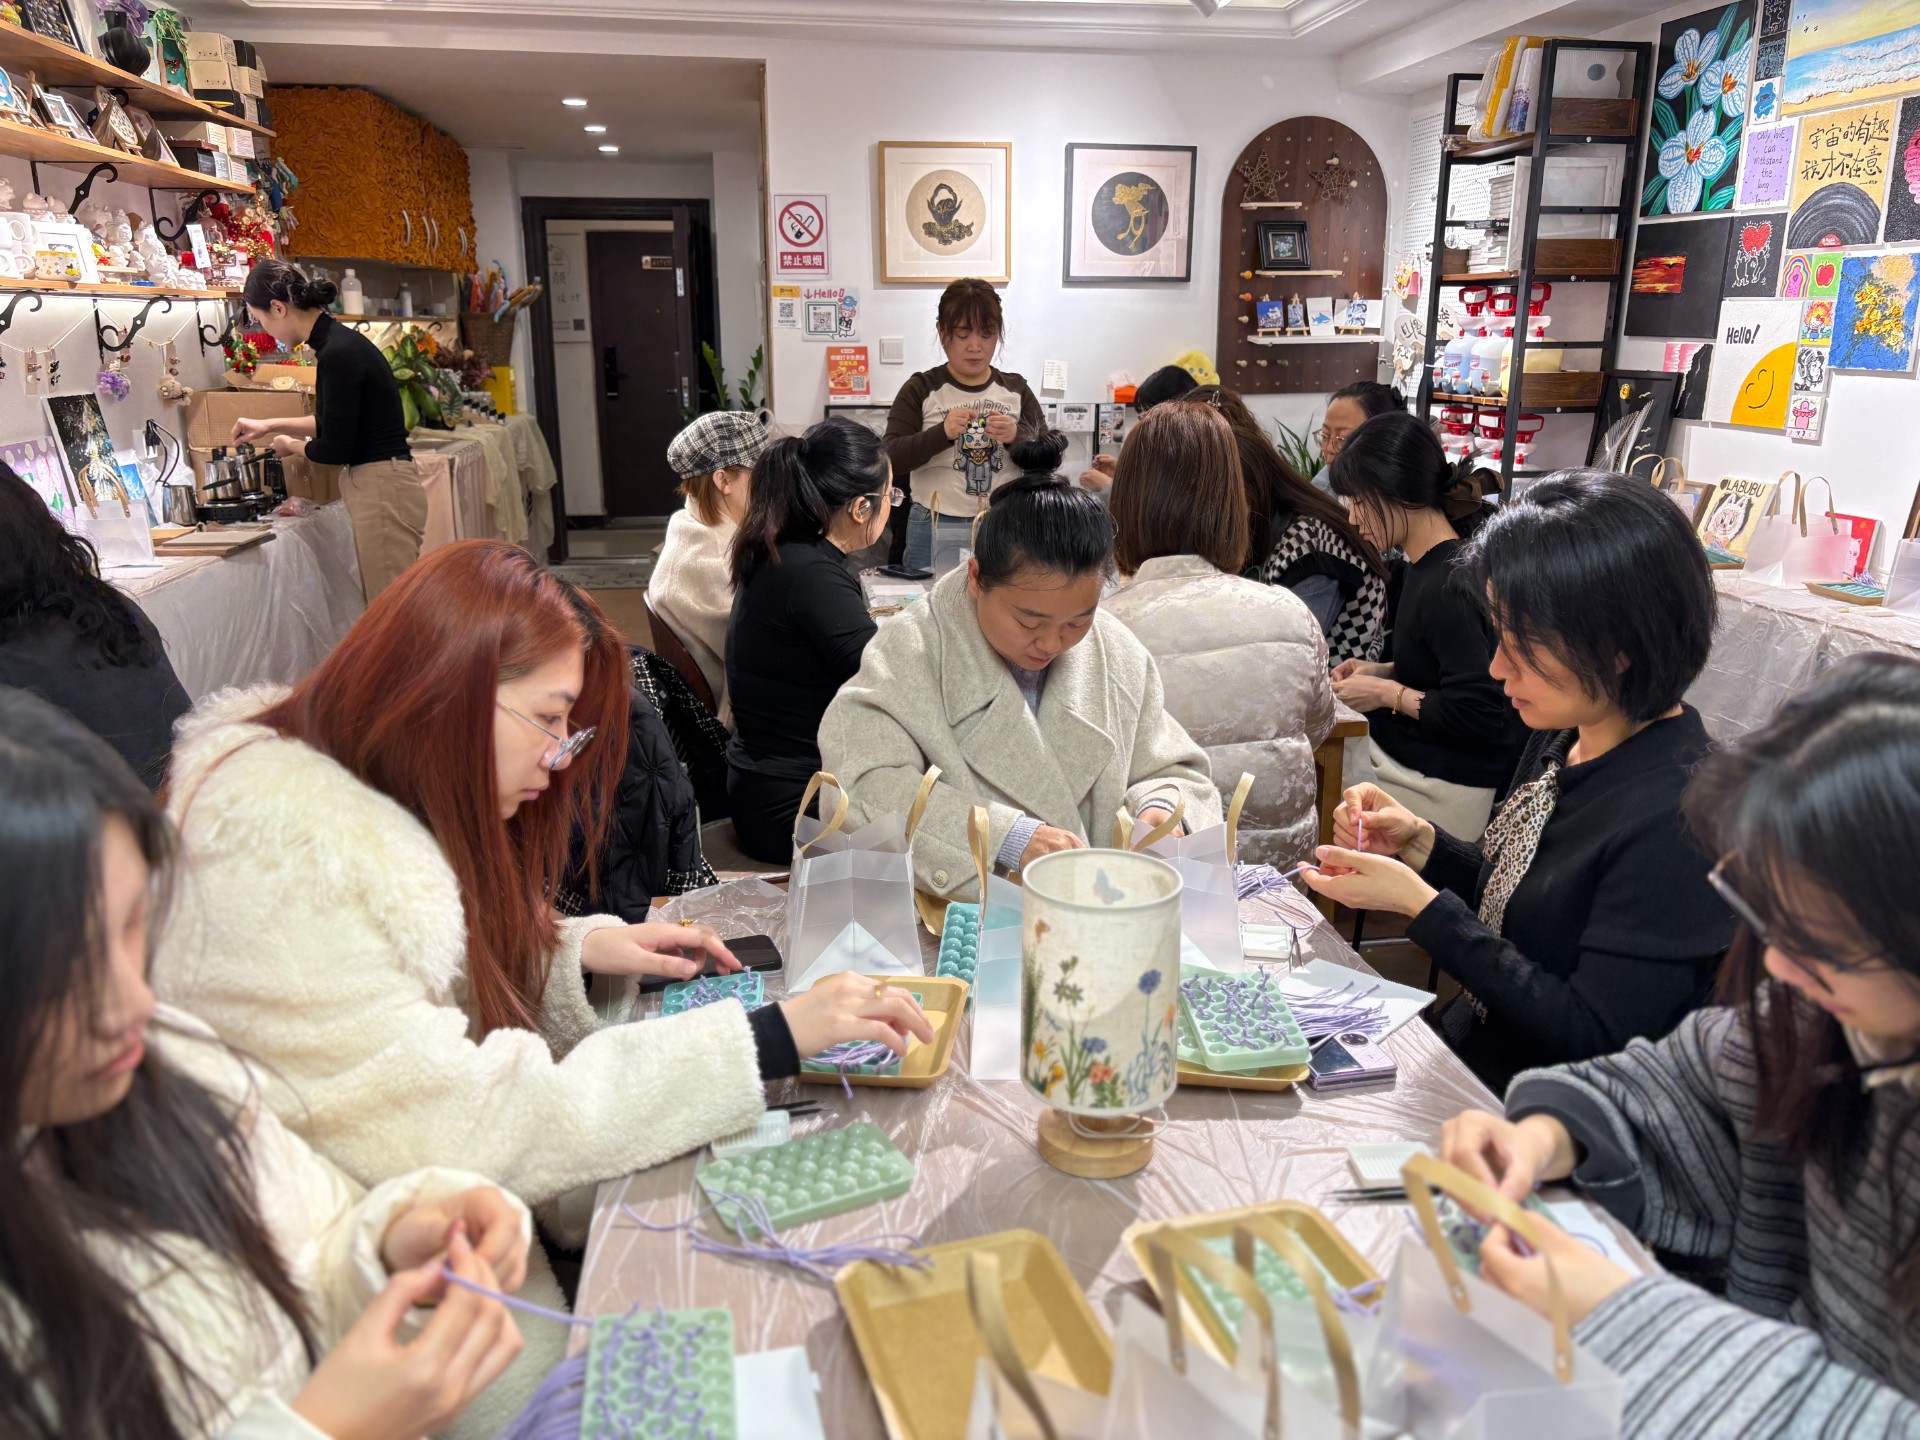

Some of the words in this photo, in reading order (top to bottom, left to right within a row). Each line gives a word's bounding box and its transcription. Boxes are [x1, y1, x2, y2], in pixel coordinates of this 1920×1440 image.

[1808, 110, 1889, 149] 宇宙的有趣
[1801, 145, 1882, 180] 我才不在意
[782, 255, 823, 266] 禁止吸烟
[813, 288, 845, 303] Hello!
[1726, 324, 1760, 344] Hello!
[1726, 480, 1766, 498] LABUBU
